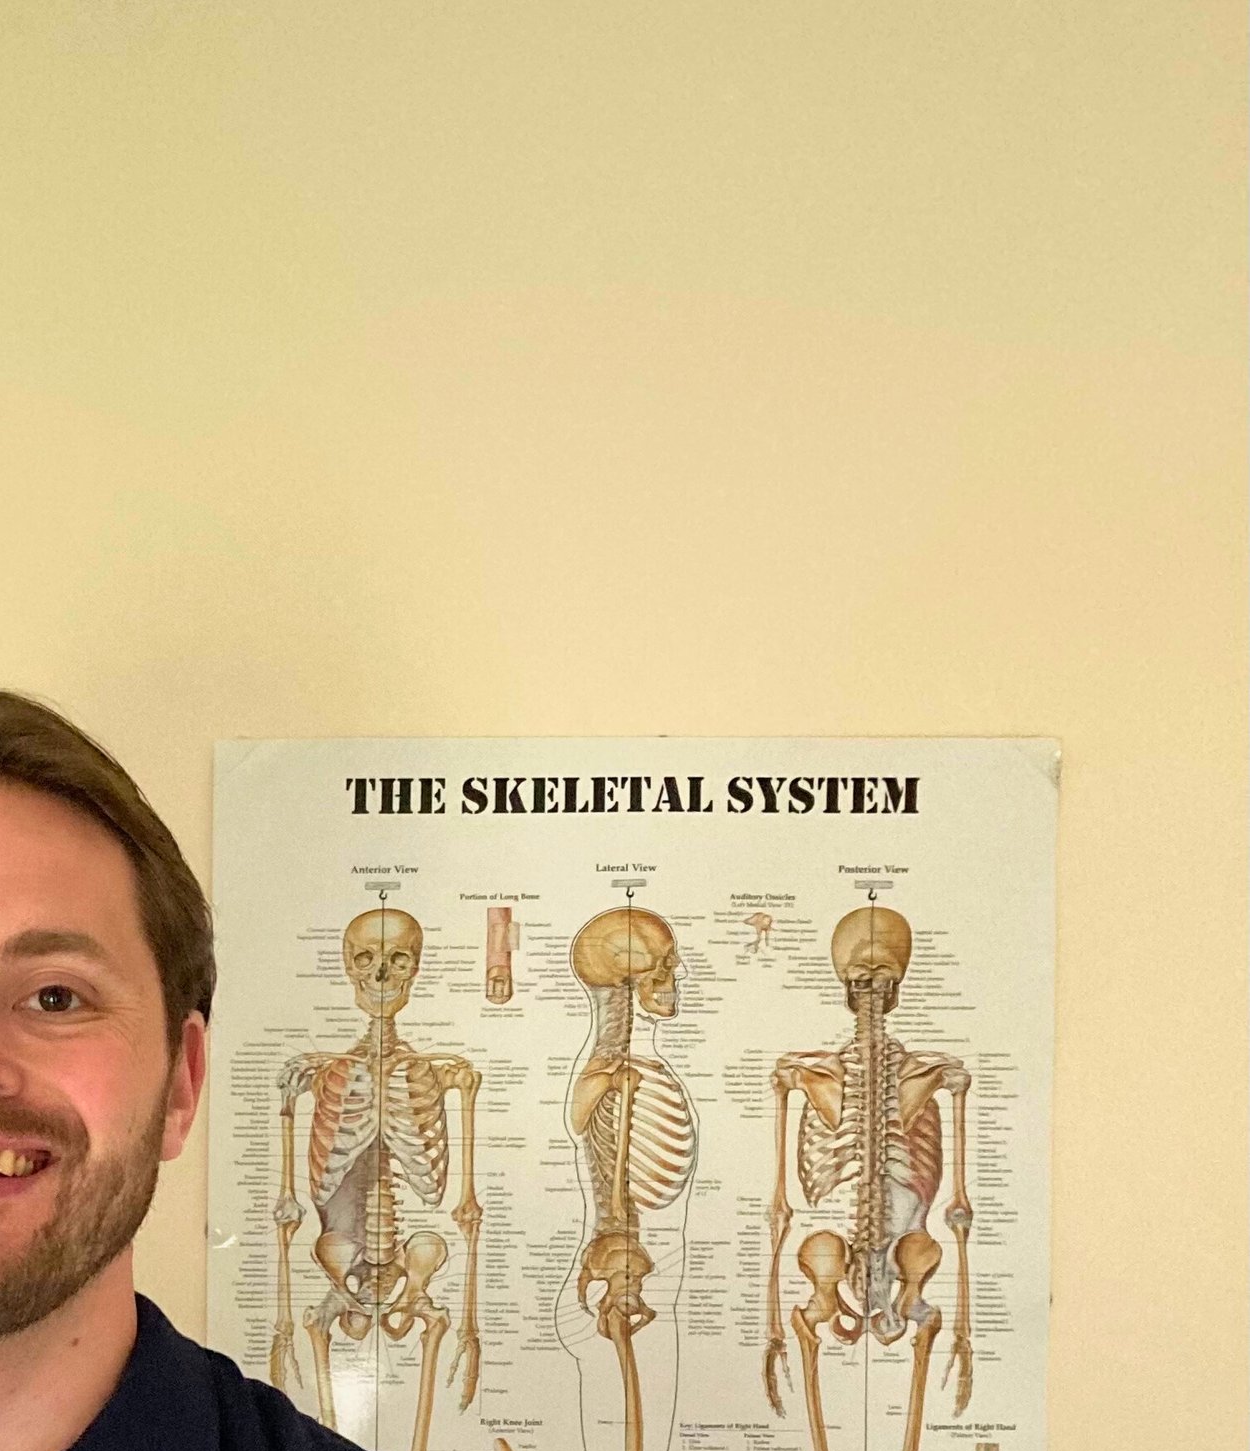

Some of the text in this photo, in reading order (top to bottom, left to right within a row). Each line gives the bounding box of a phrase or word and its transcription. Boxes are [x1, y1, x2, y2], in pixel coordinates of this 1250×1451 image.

[346, 775, 921, 815] THE SKELETAL SYSTEM
[351, 865, 419, 875] Anterior View
[596, 863, 657, 872] Lateral View
[838, 864, 909, 874] Posterior View
[480, 1418, 501, 1427] Right
[503, 1418, 522, 1426] Knee
